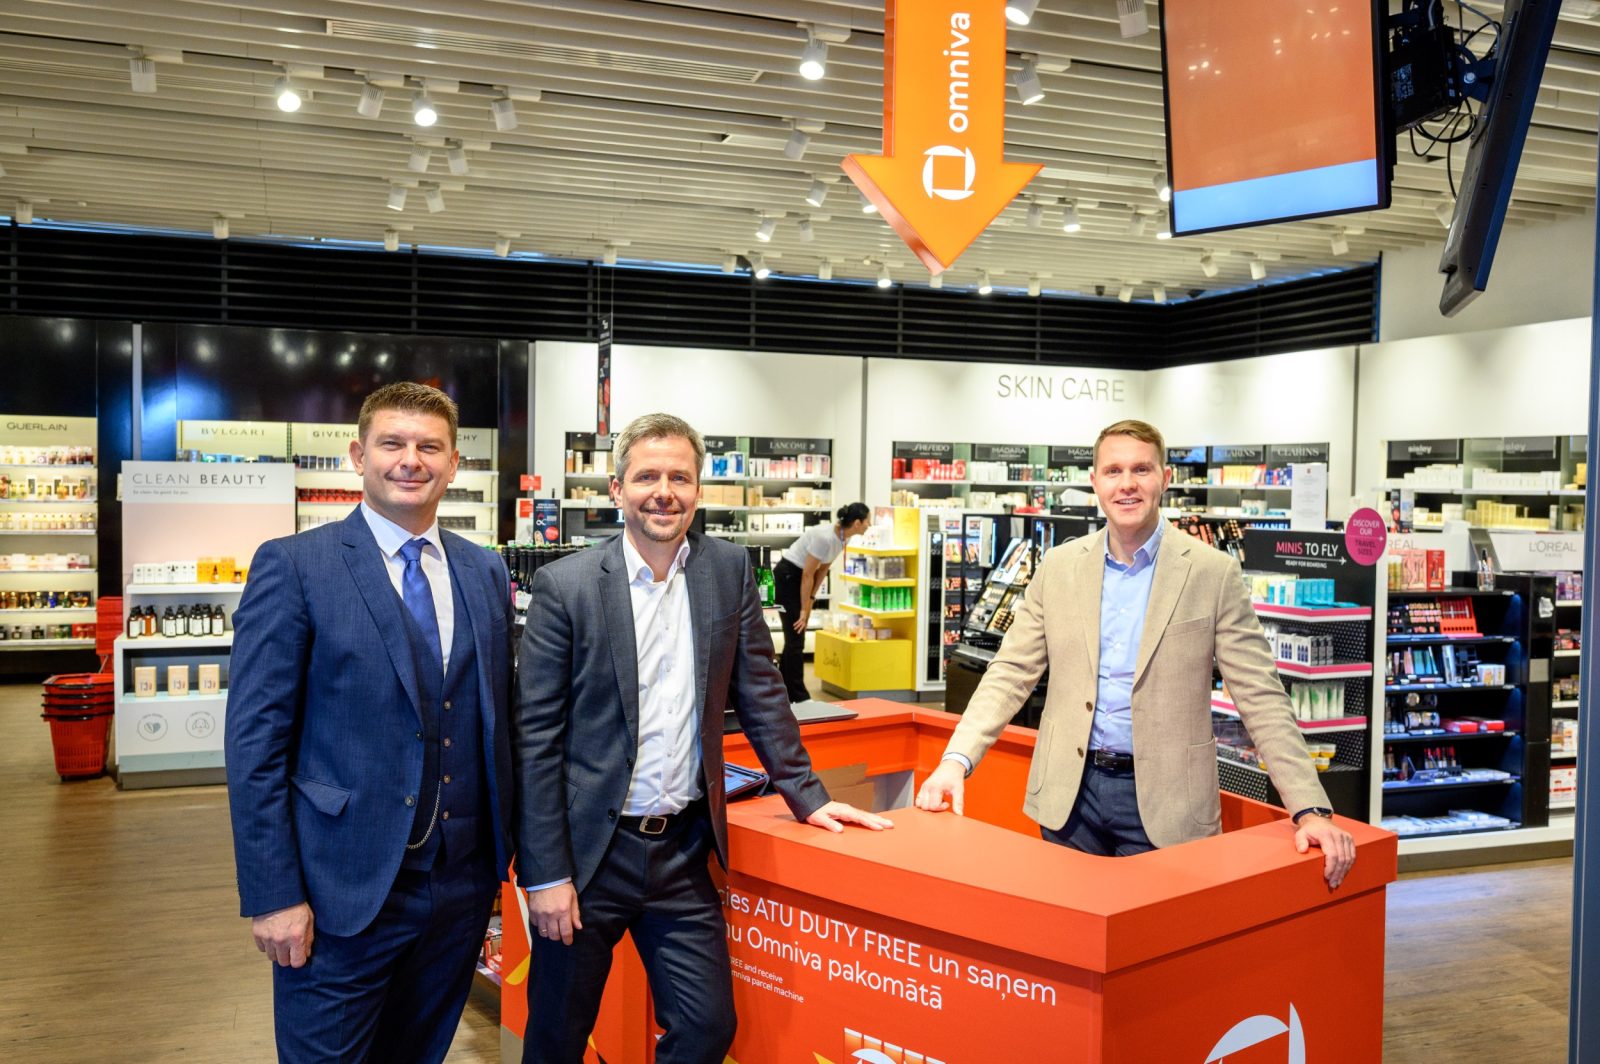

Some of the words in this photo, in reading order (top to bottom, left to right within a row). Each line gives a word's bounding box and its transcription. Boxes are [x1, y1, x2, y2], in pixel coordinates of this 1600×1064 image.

[943, 11, 971, 133] omniva
[997, 374, 1053, 399] SKIN
[1061, 377, 1125, 402] CARE
[6, 421, 68, 432] GUERLAIN
[201, 427, 266, 437] BVLGARI
[312, 430, 359, 439] GIVENC
[911, 443, 951, 453] SHISEIDO
[1276, 447, 1321, 457] CLARINS
[132, 473, 190, 485] CLEAN
[199, 474, 267, 485] BEAUTY
[1352, 519, 1380, 529] DISCOVER
[1359, 527, 1373, 536] OUR
[1275, 541, 1304, 556] MINIS
[1305, 542, 1320, 556] TO
[1321, 544, 1339, 557] FLY
[1355, 539, 1377, 548] TRAVEL
[1306, 561, 1328, 569] BOARDING
[754, 897, 793, 928] ATU
[800, 910, 859, 948] DUTY
[864, 929, 922, 968] FREE
[928, 954, 960, 979] un
[967, 965, 1057, 1007] saņem
[744, 963, 758, 975] and
[757, 968, 784, 984] receive
[747, 926, 823, 972] Omniva
[828, 959, 943, 1011] pakomātā
[751, 978, 773, 992] parcel
[773, 986, 805, 1004] machine
